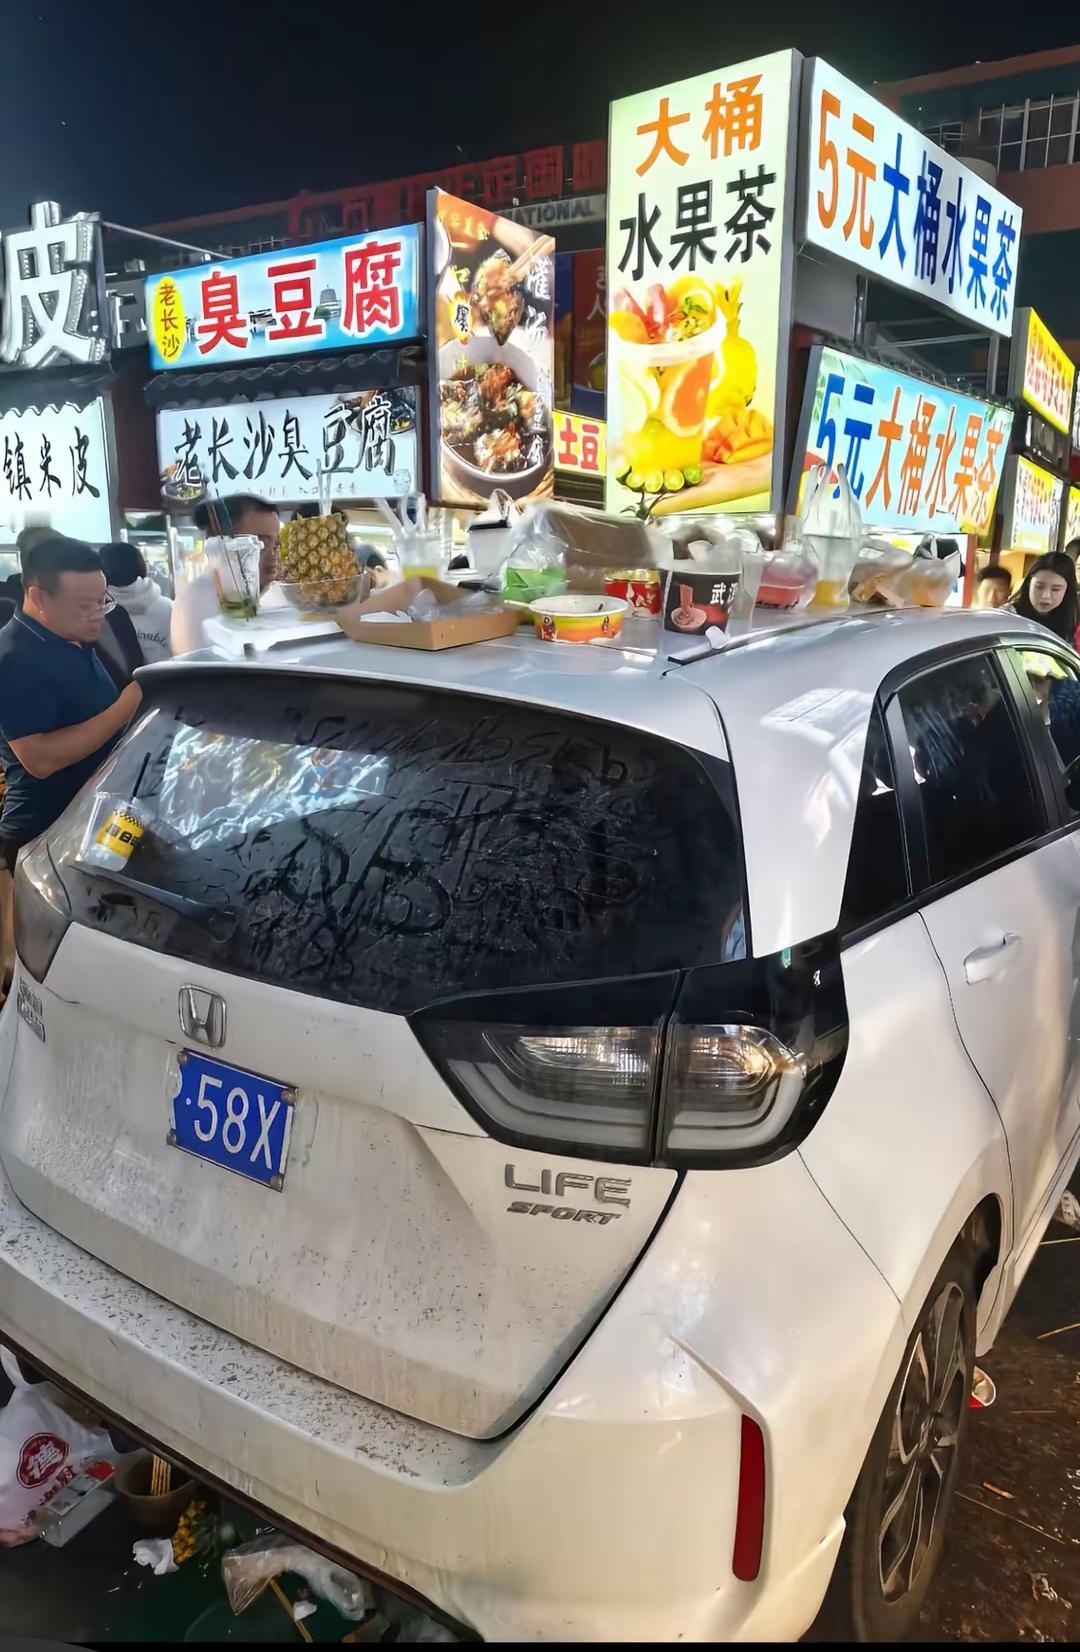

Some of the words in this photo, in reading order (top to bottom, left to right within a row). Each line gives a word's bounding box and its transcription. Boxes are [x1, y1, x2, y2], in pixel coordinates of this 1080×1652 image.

[635, 73, 764, 178] 大桶
[618, 164, 778, 281] 水果茶
[816, 88, 1022, 322] 5元大桶水果茶
[0, 200, 102, 367] 皮
[159, 282, 182, 358] 老长沙
[198, 240, 402, 356] 臭豆腐
[172, 396, 396, 487] 老长沙臭豆腐
[816, 372, 1005, 530] 5元大桶水果茶
[504, 1163, 632, 1208] LIFE
[506, 1201, 622, 1225] SPORT
